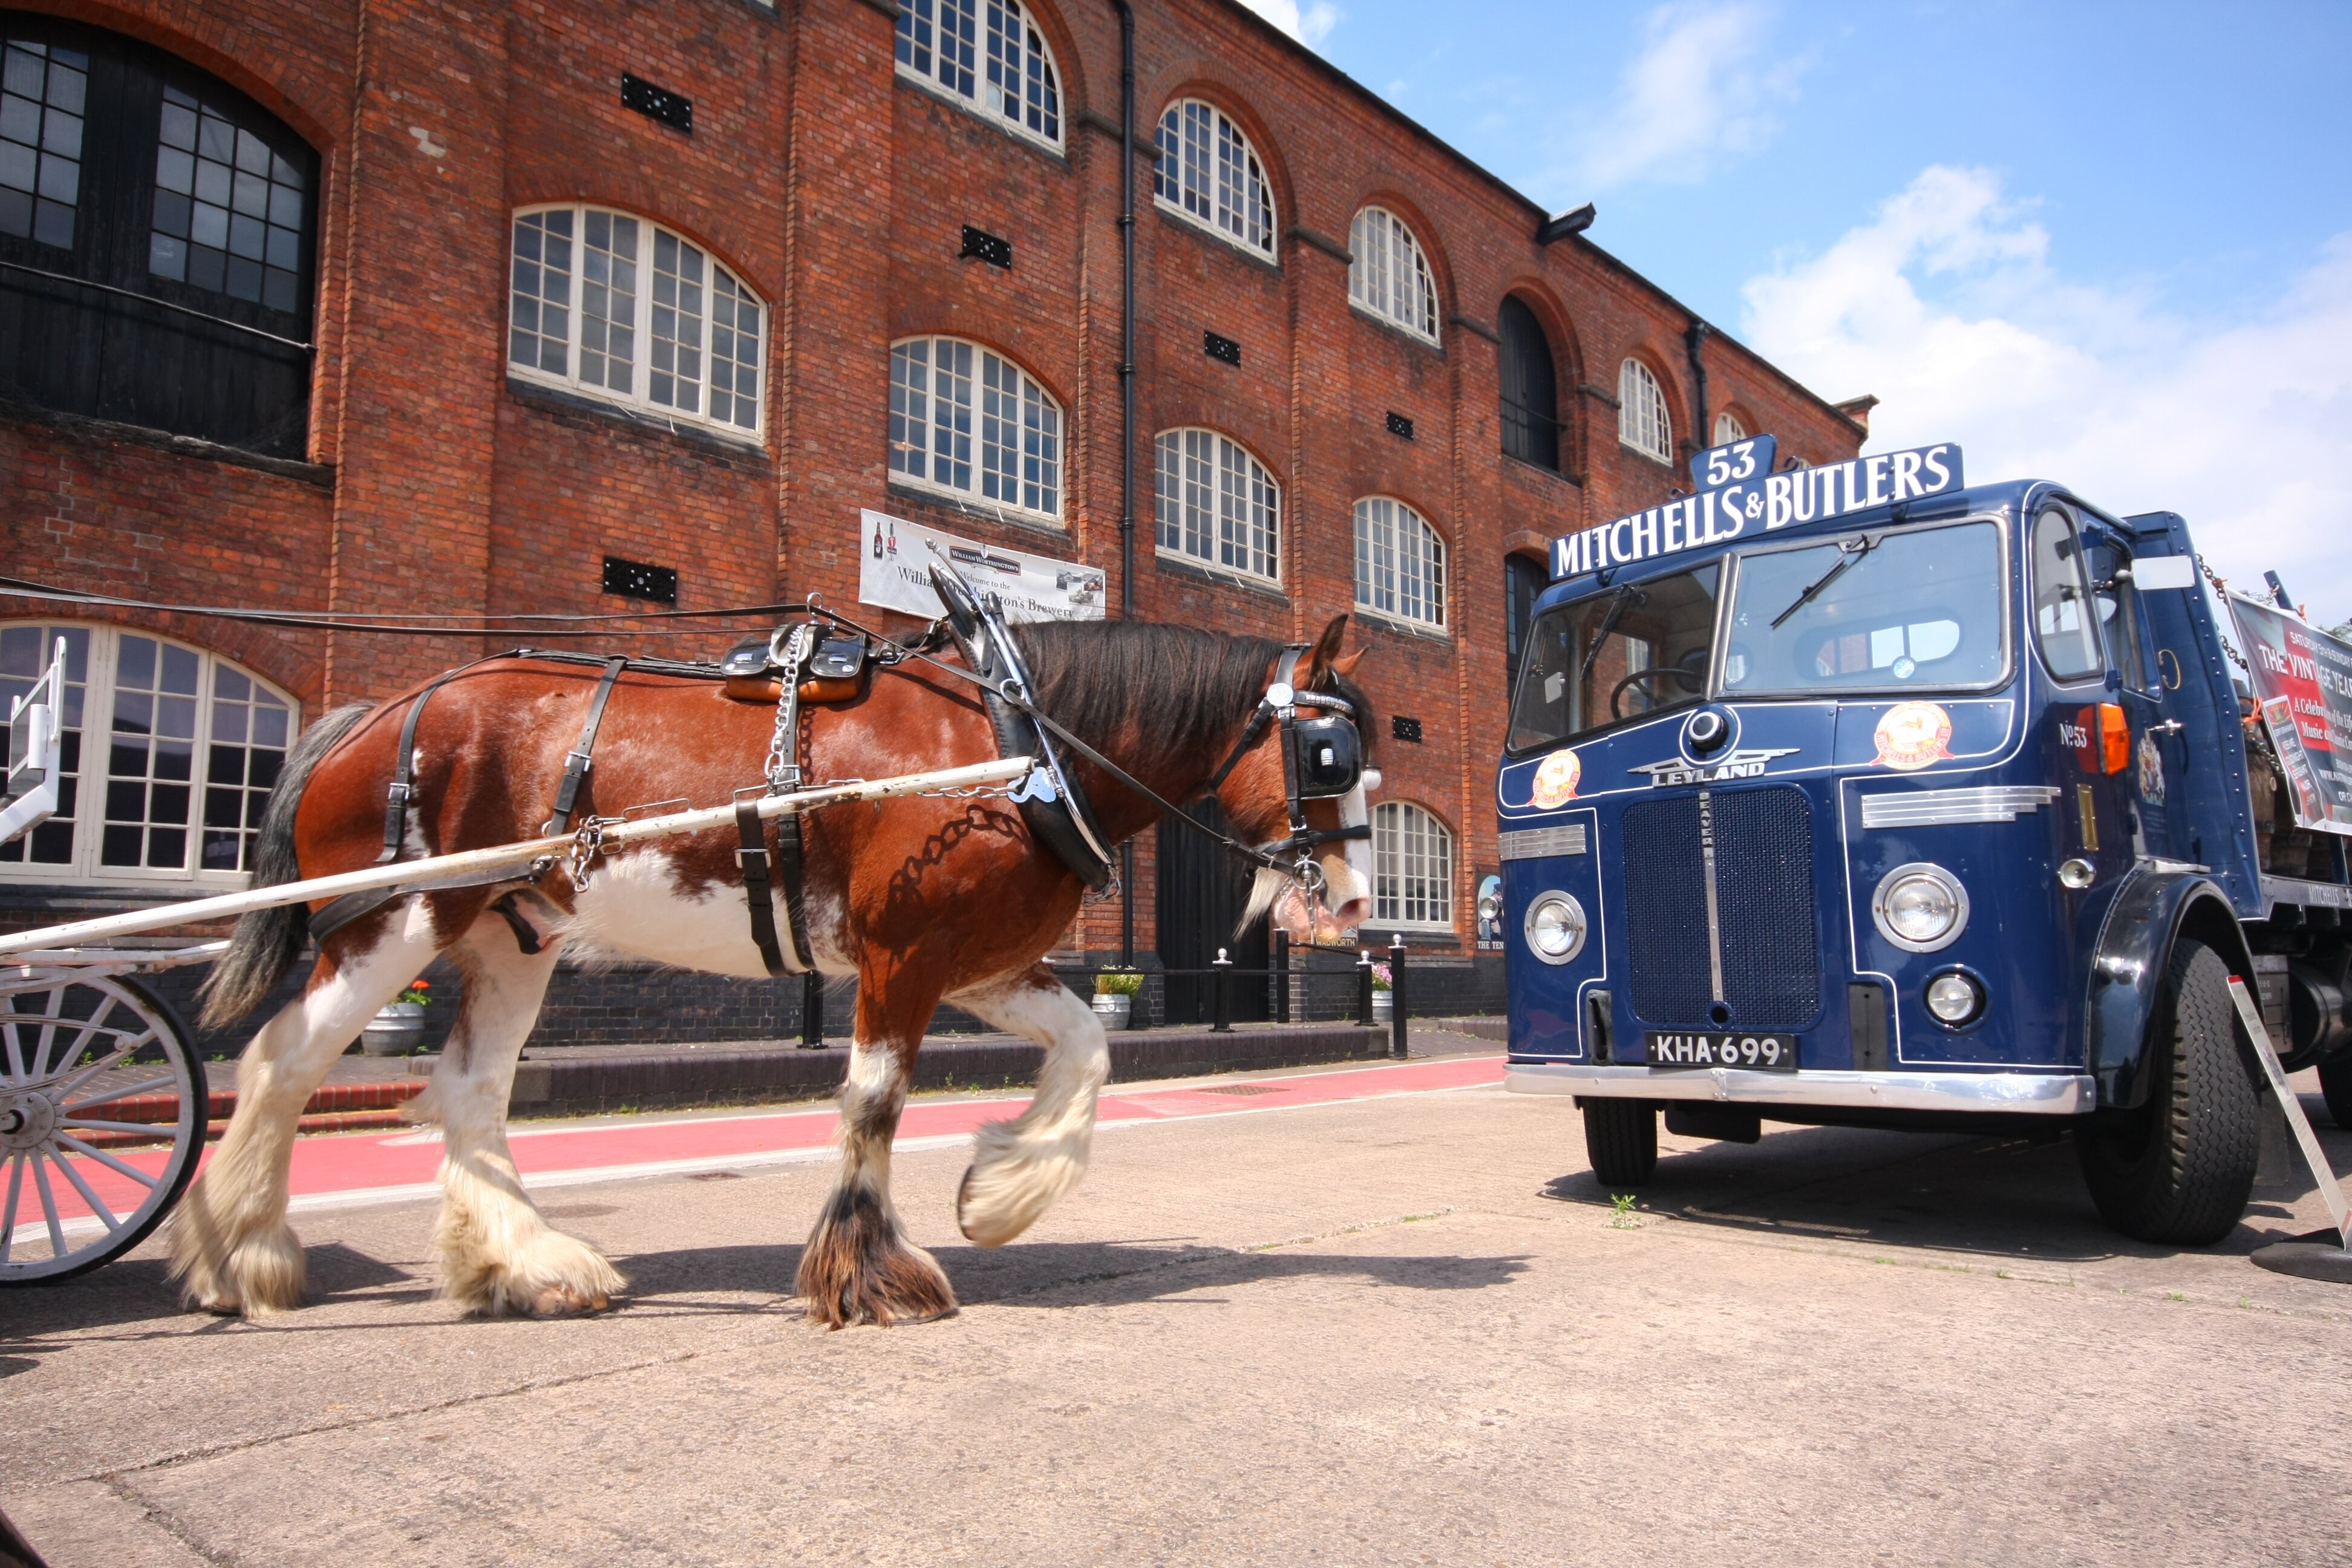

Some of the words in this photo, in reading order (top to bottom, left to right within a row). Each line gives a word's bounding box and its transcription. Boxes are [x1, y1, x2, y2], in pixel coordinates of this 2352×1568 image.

[1707, 442, 1756, 485] 53
[1557, 485, 1745, 577] MITCHELLS
[1765, 445, 1951, 530] BUTLERS
[897, 566, 933, 588] Willia
[1028, 598, 1074, 618] Brewery
[959, 570, 988, 584] Welcome
[1000, 581, 1011, 590] the
[2258, 644, 2288, 675] THE
[2287, 653, 2334, 691] VINTAGE
[2295, 696, 2301, 713] A
[2301, 720, 2323, 740] Music
[1652, 762, 1766, 787] LEYLAND
[1699, 792, 1713, 846] BEAVER
[2308, 884, 2340, 906] MITCHELLS
[1477, 941, 1490, 949] THE
[1656, 1035, 1713, 1063] KHA
[1720, 1037, 1780, 1065] 699
